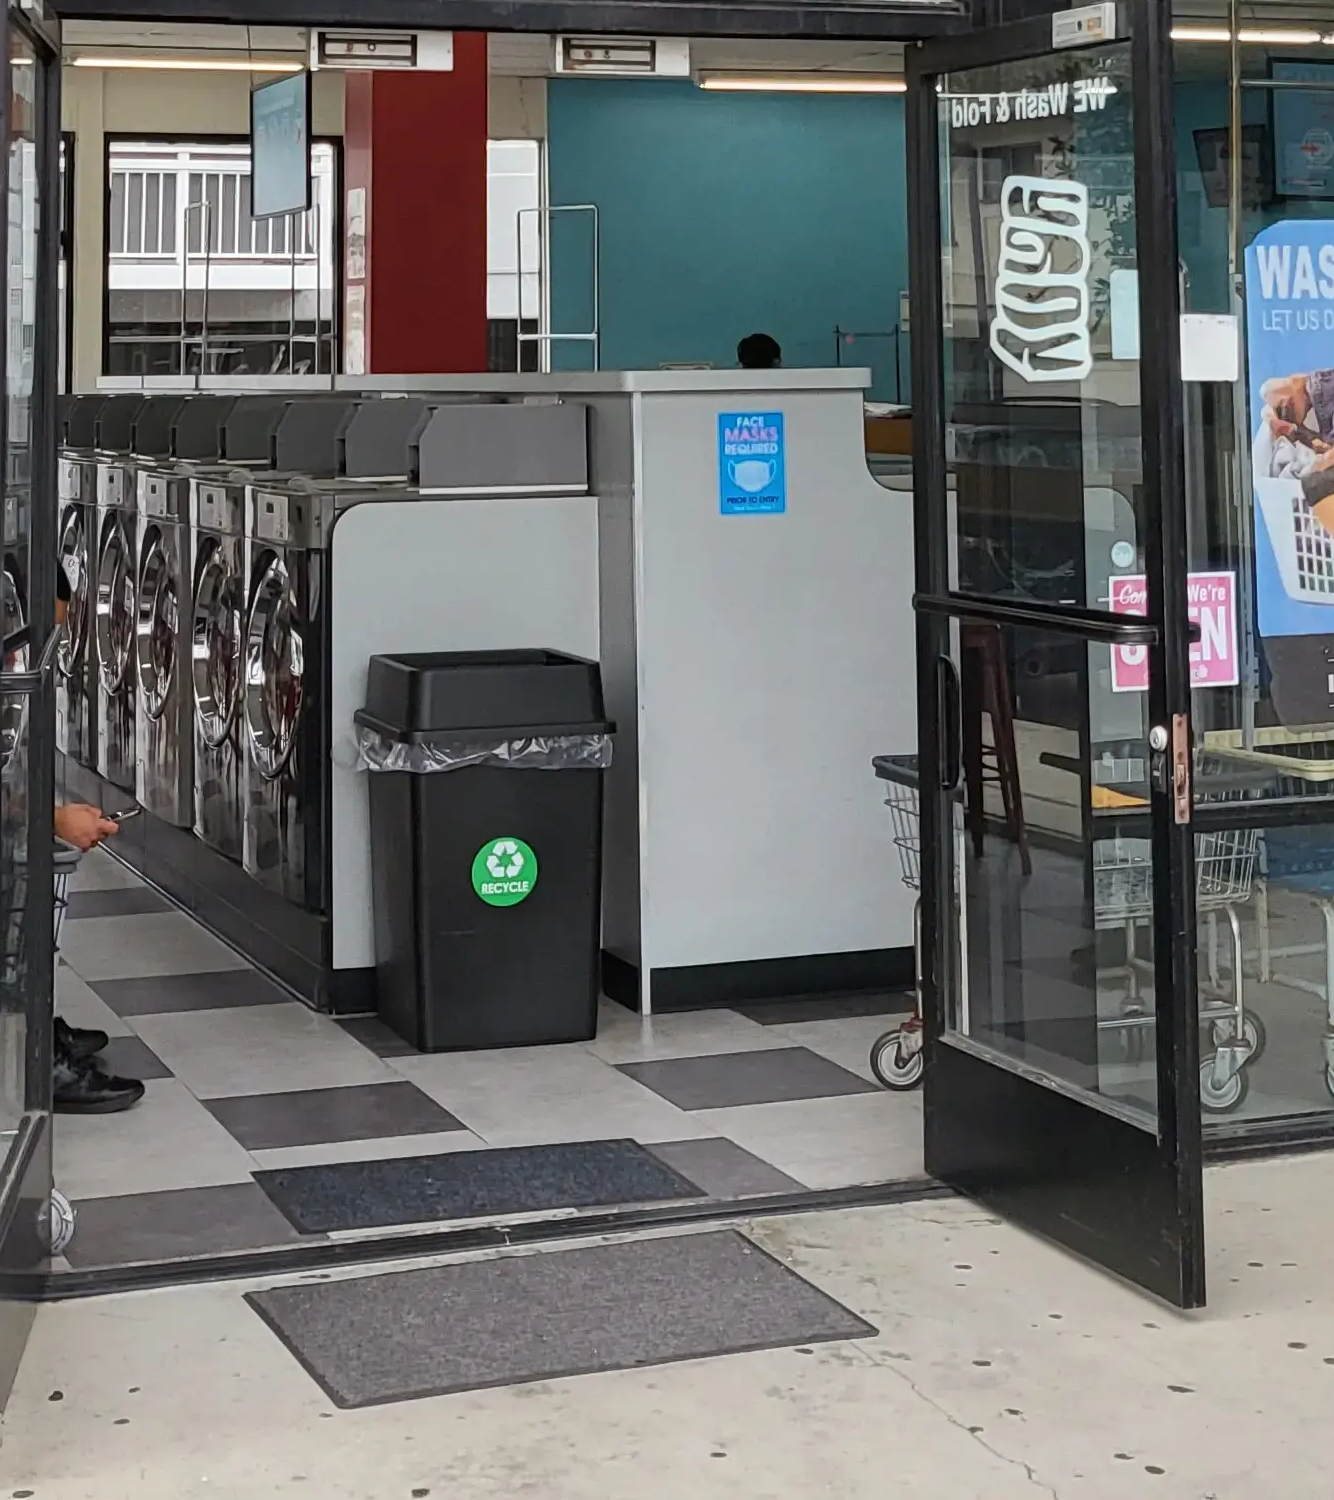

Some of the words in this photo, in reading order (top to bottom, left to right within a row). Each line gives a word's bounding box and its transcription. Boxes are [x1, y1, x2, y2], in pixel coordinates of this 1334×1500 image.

[1262, 309, 1292, 331] LET
[1296, 309, 1319, 331] US
[736, 416, 764, 428] FACE
[724, 426, 779, 442] MASKS
[724, 442, 778, 456] REQUIRED
[1187, 584, 1227, 602] We're
[481, 881, 529, 895] RECYCLE
